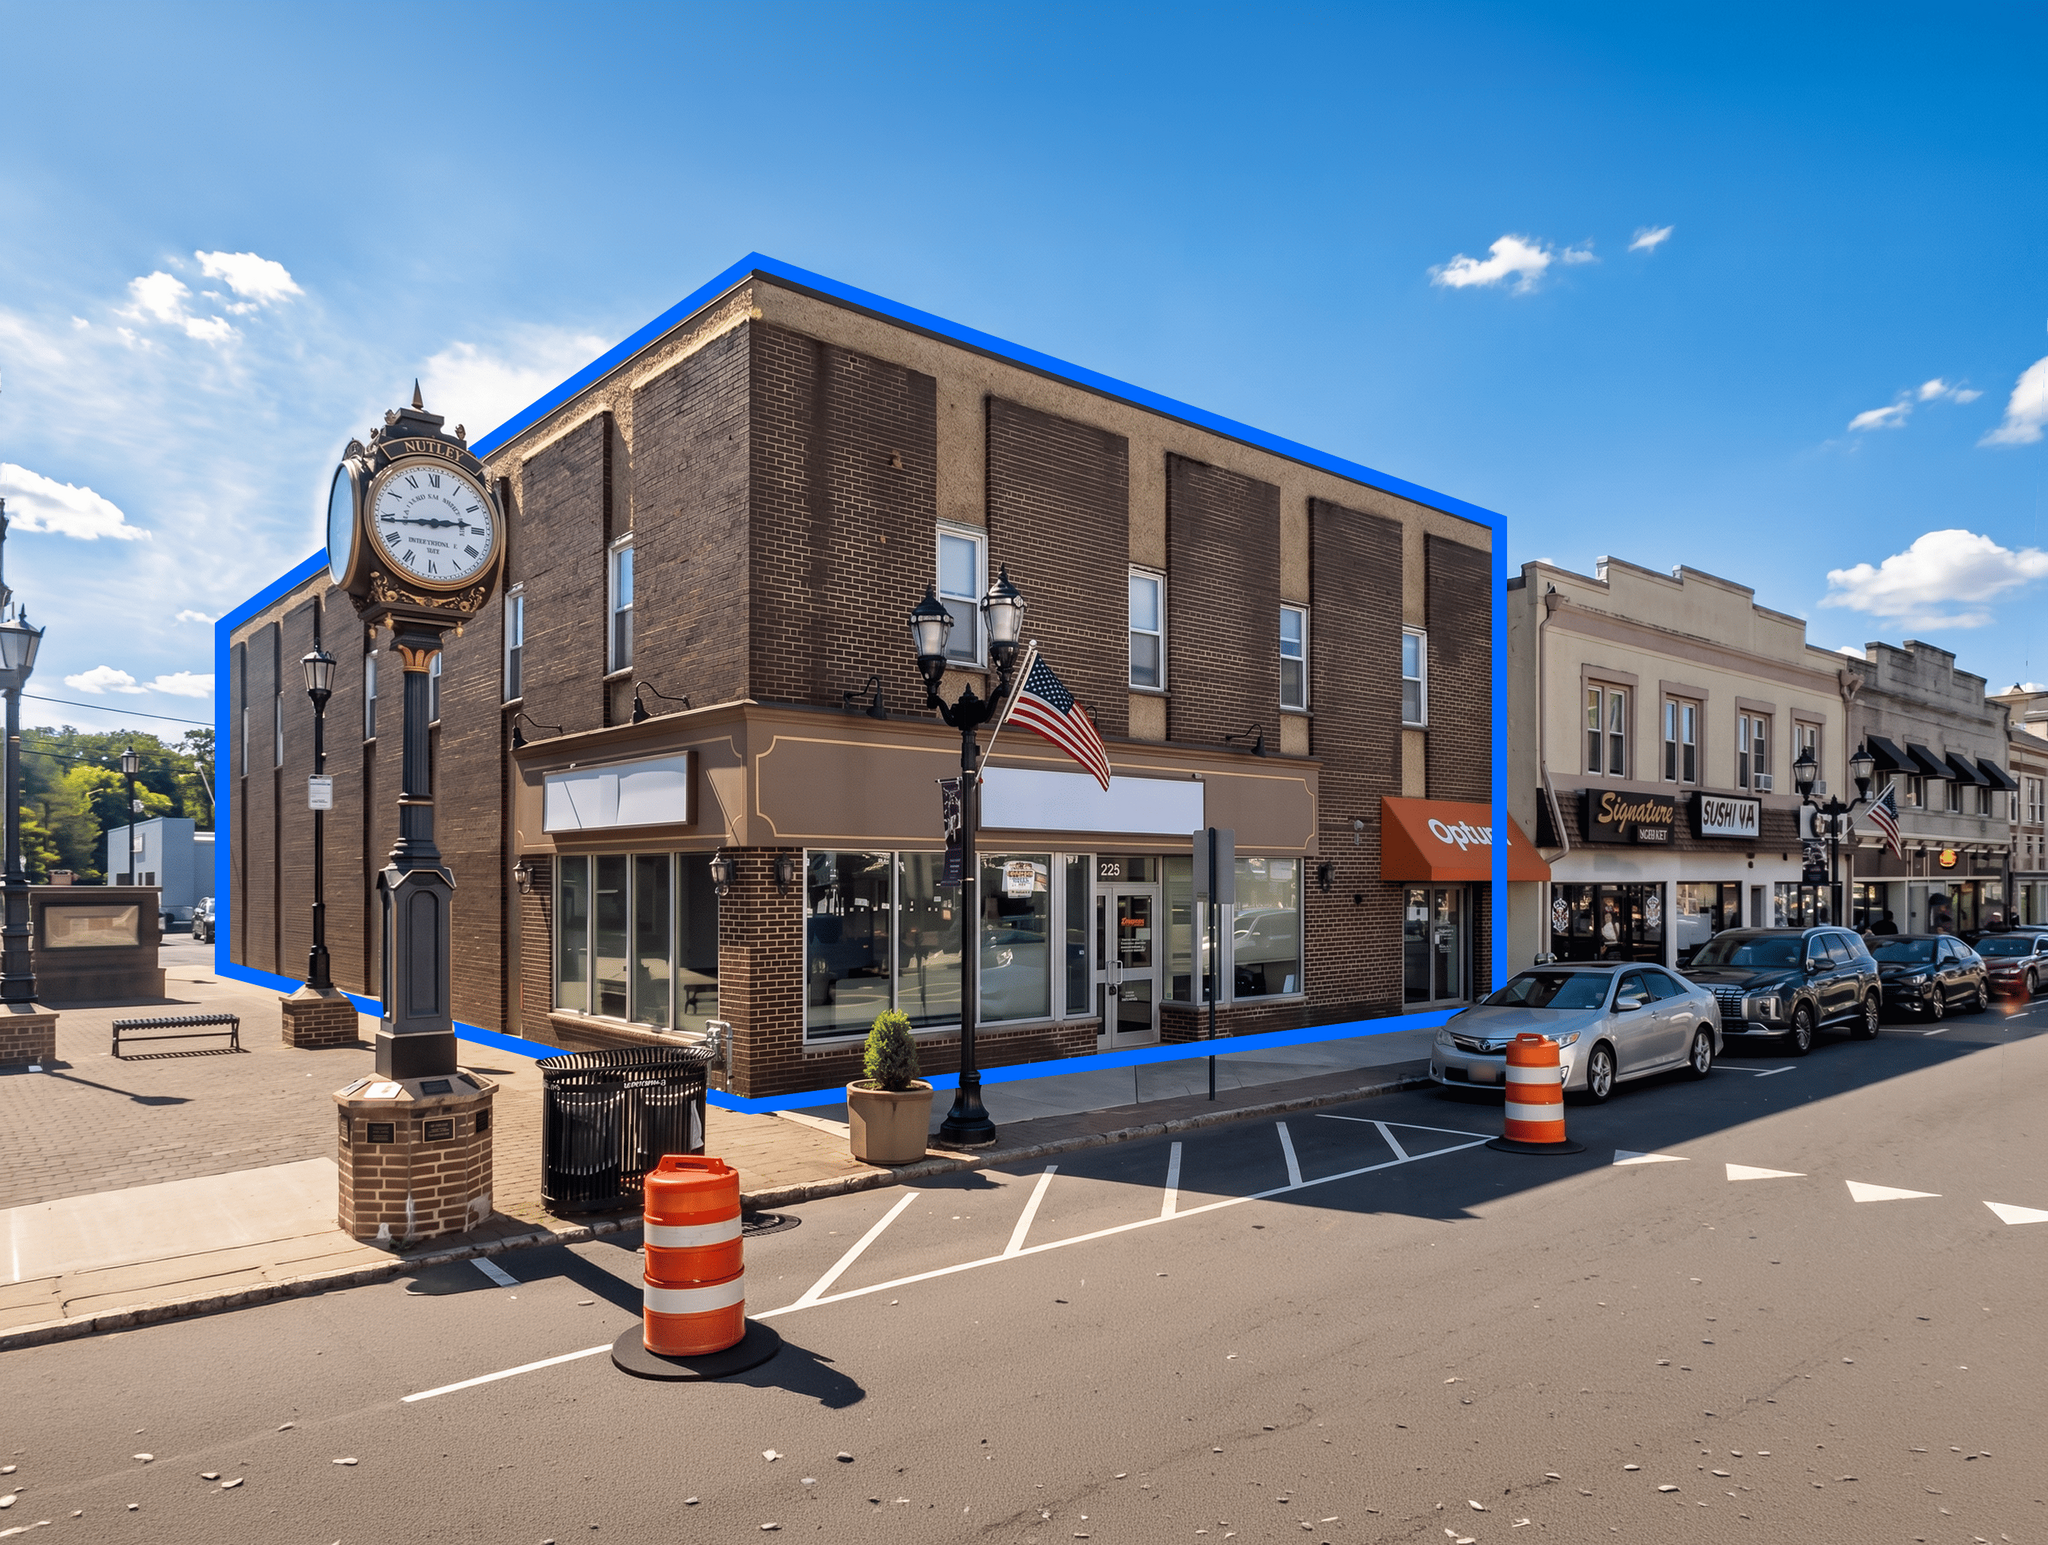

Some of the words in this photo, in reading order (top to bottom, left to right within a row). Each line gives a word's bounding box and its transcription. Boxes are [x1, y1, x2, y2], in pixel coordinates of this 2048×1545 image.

[404, 440, 464, 462] NUTLEY
[428, 473, 440, 489] XII
[1598, 791, 1674, 834] Signature
[1703, 800, 1737, 828] SUSHI
[1101, 863, 1120, 876] 225
